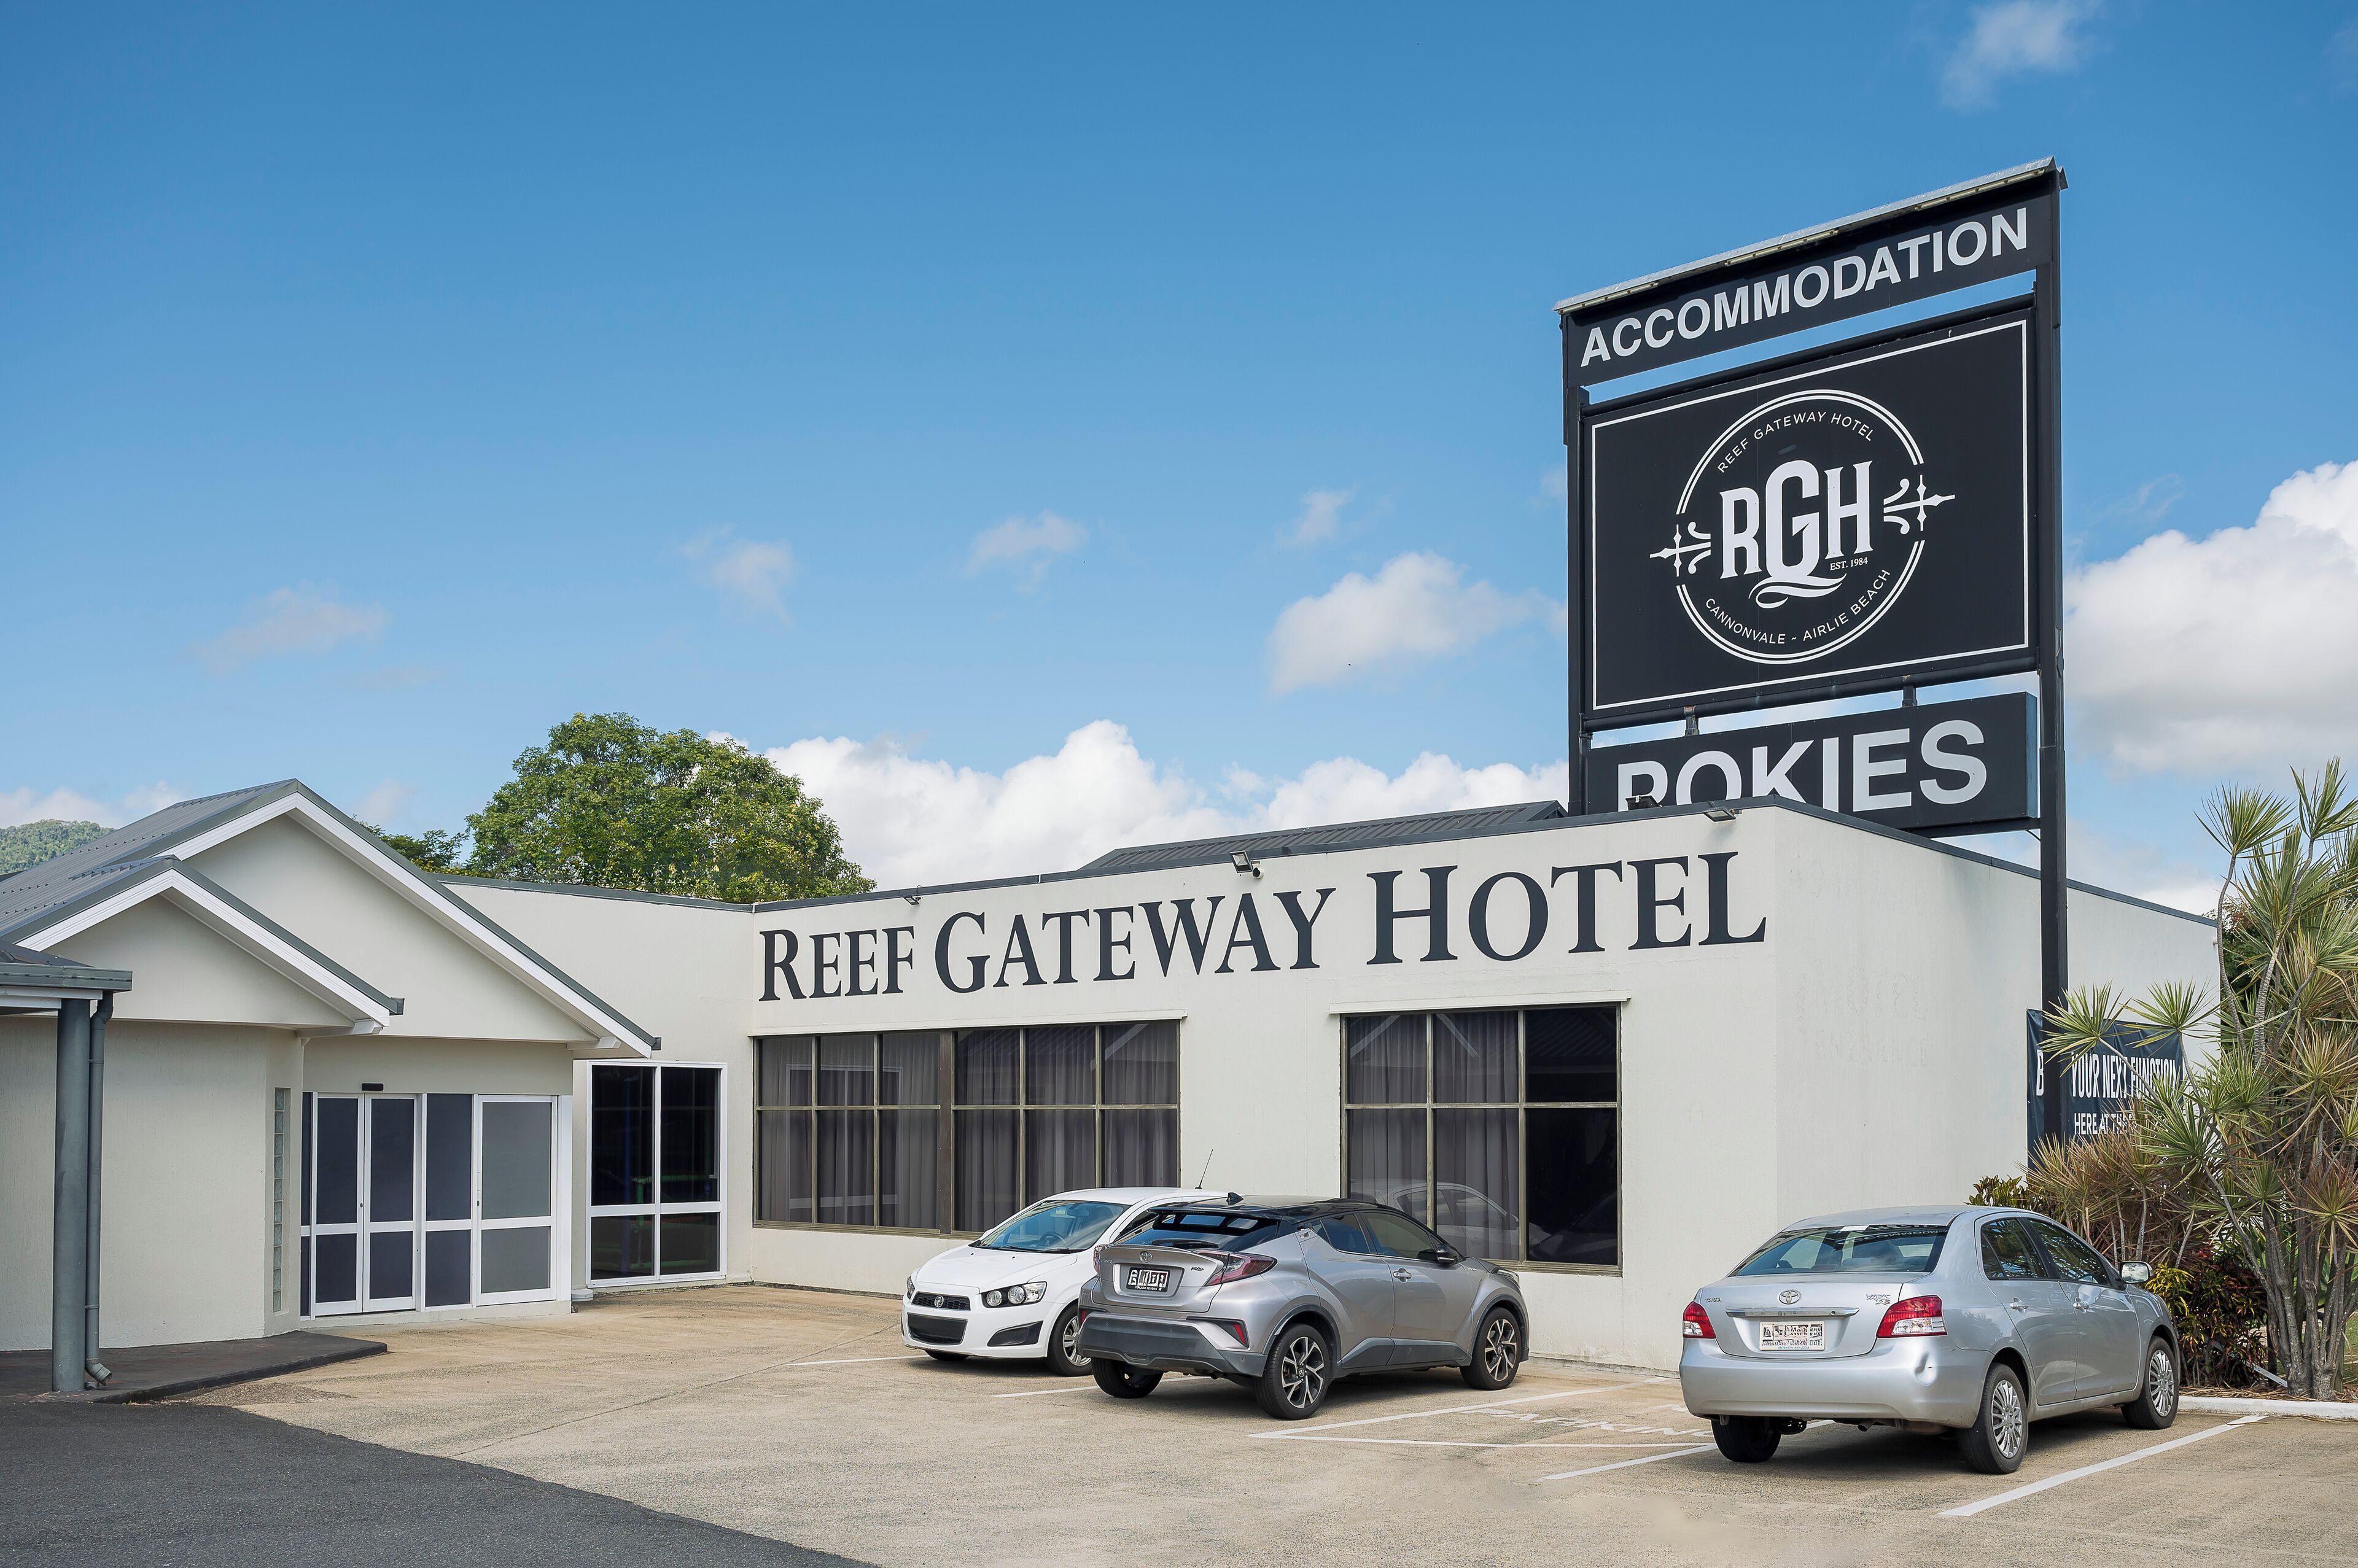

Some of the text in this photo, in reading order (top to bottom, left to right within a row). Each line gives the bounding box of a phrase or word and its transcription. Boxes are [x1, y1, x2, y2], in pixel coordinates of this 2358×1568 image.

[1581, 208, 2028, 367] ACCOMMODATION
[1717, 411, 1874, 473] REEF GATEWAY HOTEL
[1719, 460, 1874, 608] RGH
[1829, 556, 1869, 571] EST. 1984
[1705, 598, 1786, 644] CANNONVALE
[1803, 612, 1849, 641] AIRLIE
[1850, 569, 1891, 615] BEACH
[1617, 720, 1988, 813] POKIES
[758, 851, 1767, 1001] REEF GATEWAY HOTEL
[2071, 1052, 2099, 1098] YOUR
[2103, 1055, 2128, 1099] NEXT
[2074, 1112, 2098, 1135] HERE
